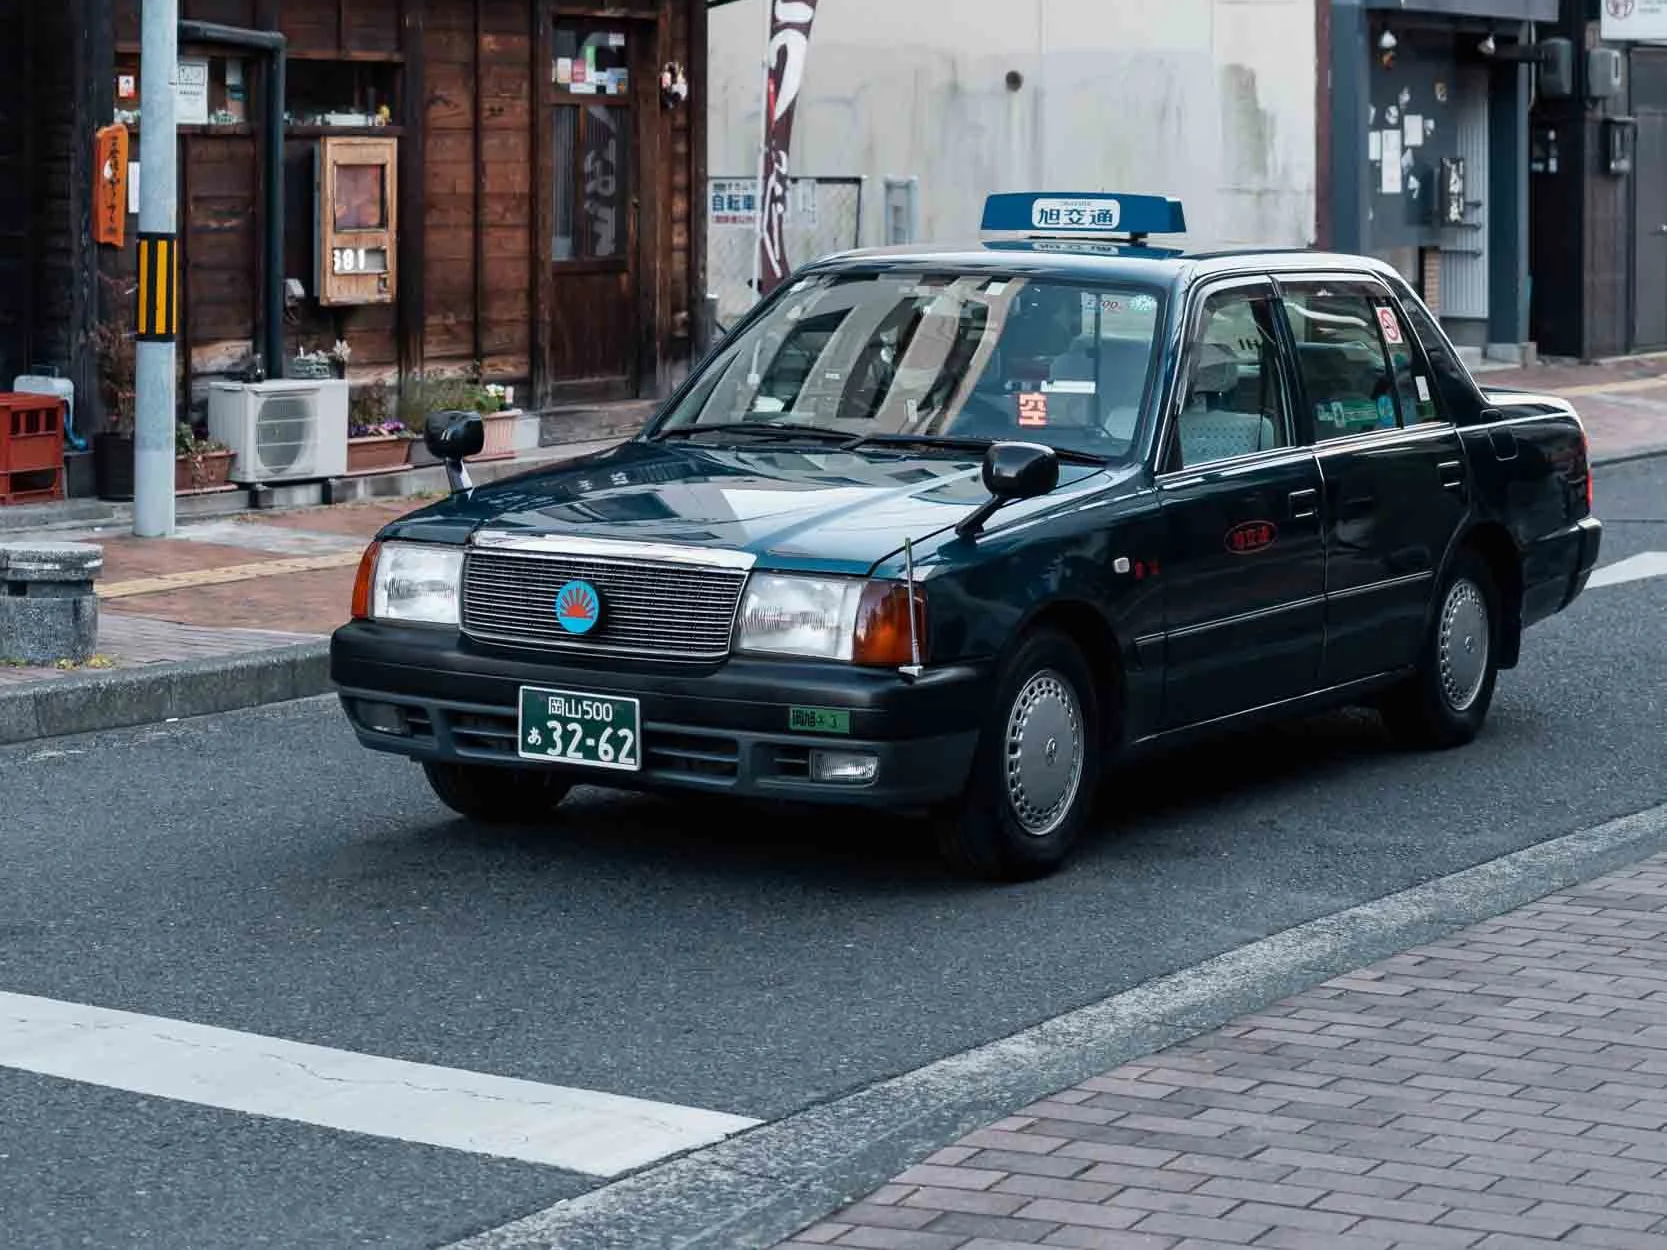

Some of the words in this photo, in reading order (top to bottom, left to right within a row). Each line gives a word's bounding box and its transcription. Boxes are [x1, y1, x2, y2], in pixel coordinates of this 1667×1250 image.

[1037, 207, 1113, 226] 旭交通
[1019, 392, 1047, 426] 空
[548, 696, 613, 722] 岡山500
[527, 726, 542, 746] あ
[546, 720, 635, 764] 32-62
